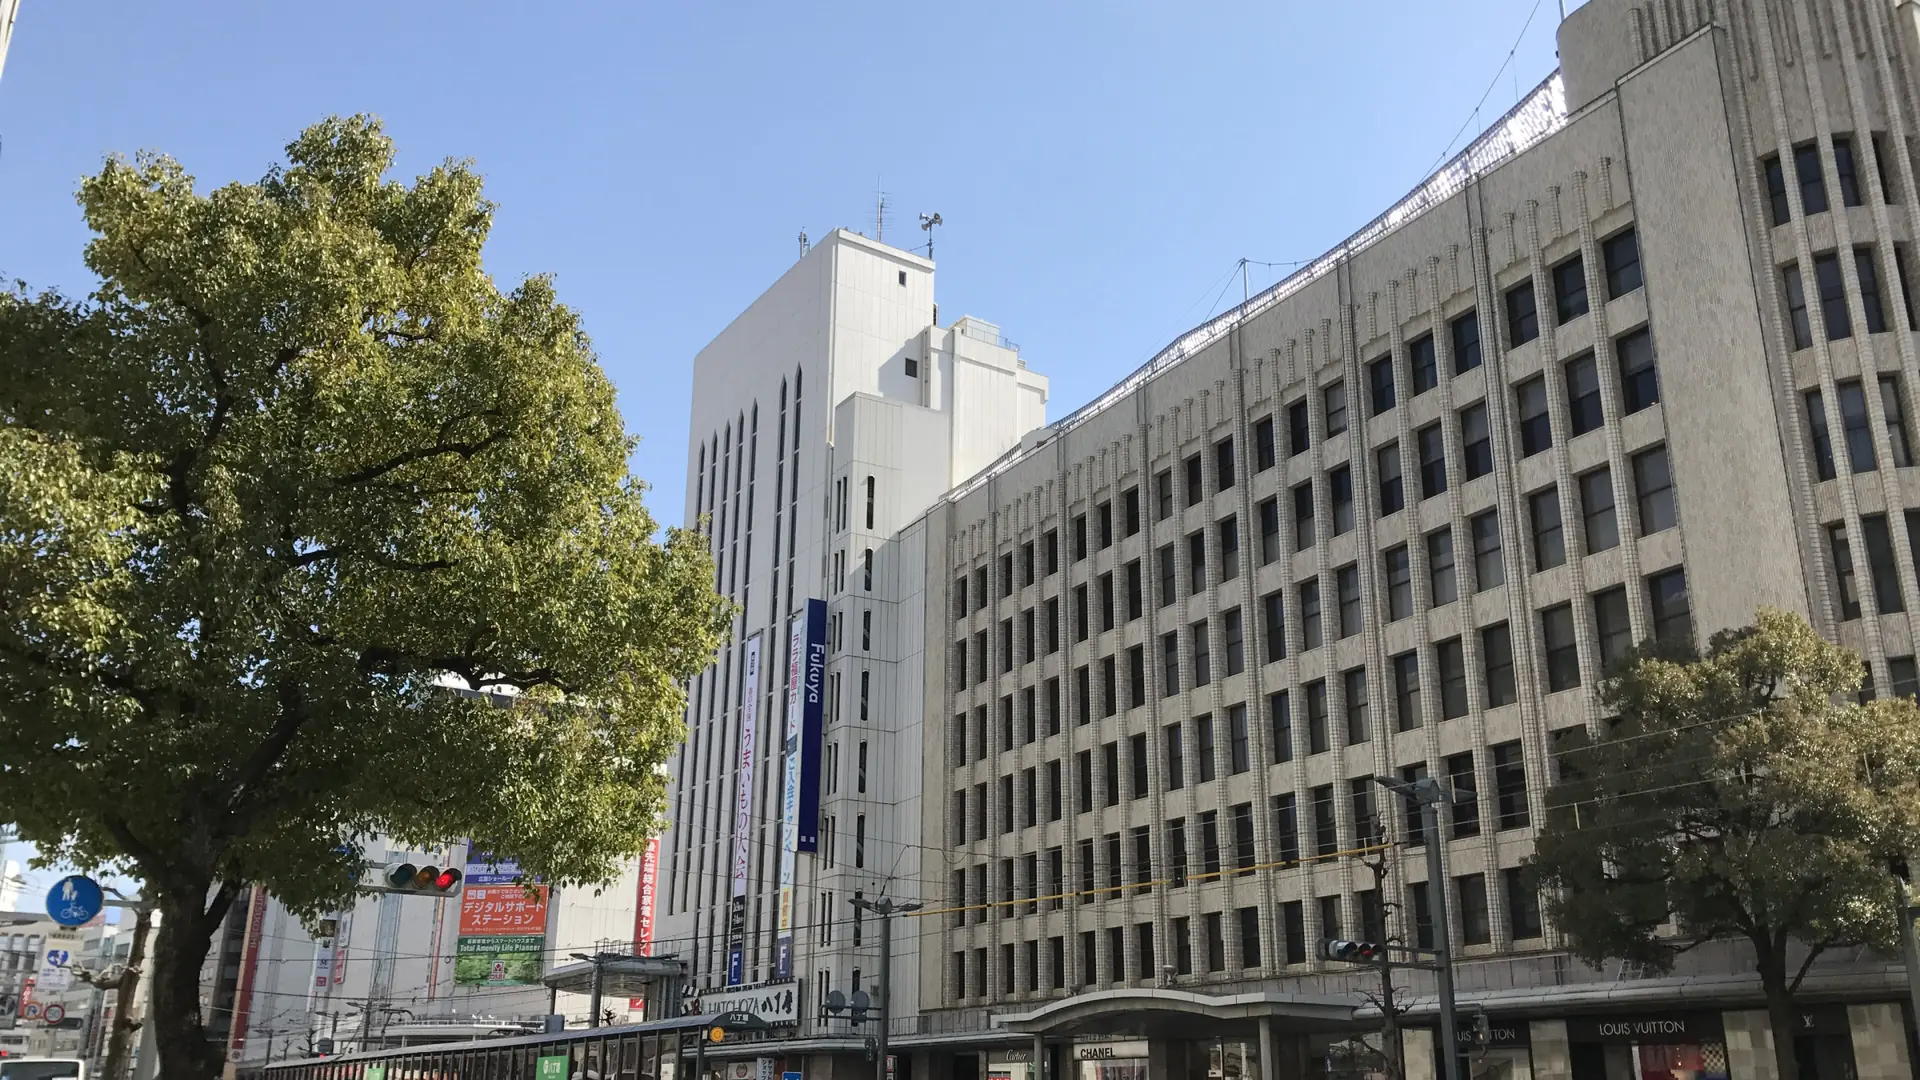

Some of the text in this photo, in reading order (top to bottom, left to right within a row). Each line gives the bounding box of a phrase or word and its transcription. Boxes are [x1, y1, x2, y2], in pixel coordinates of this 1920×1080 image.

[806, 643, 825, 704] Fukuya
[463, 901, 544, 913] デジタルサポート
[471, 914, 534, 926] ステーション
[460, 942, 541, 953] Total Amenity Life Planner
[1599, 1020, 1685, 1036] LOUIS VUITTON
[1005, 1050, 1027, 1061] Cartier
[1080, 1047, 1116, 1059] CHANEL
